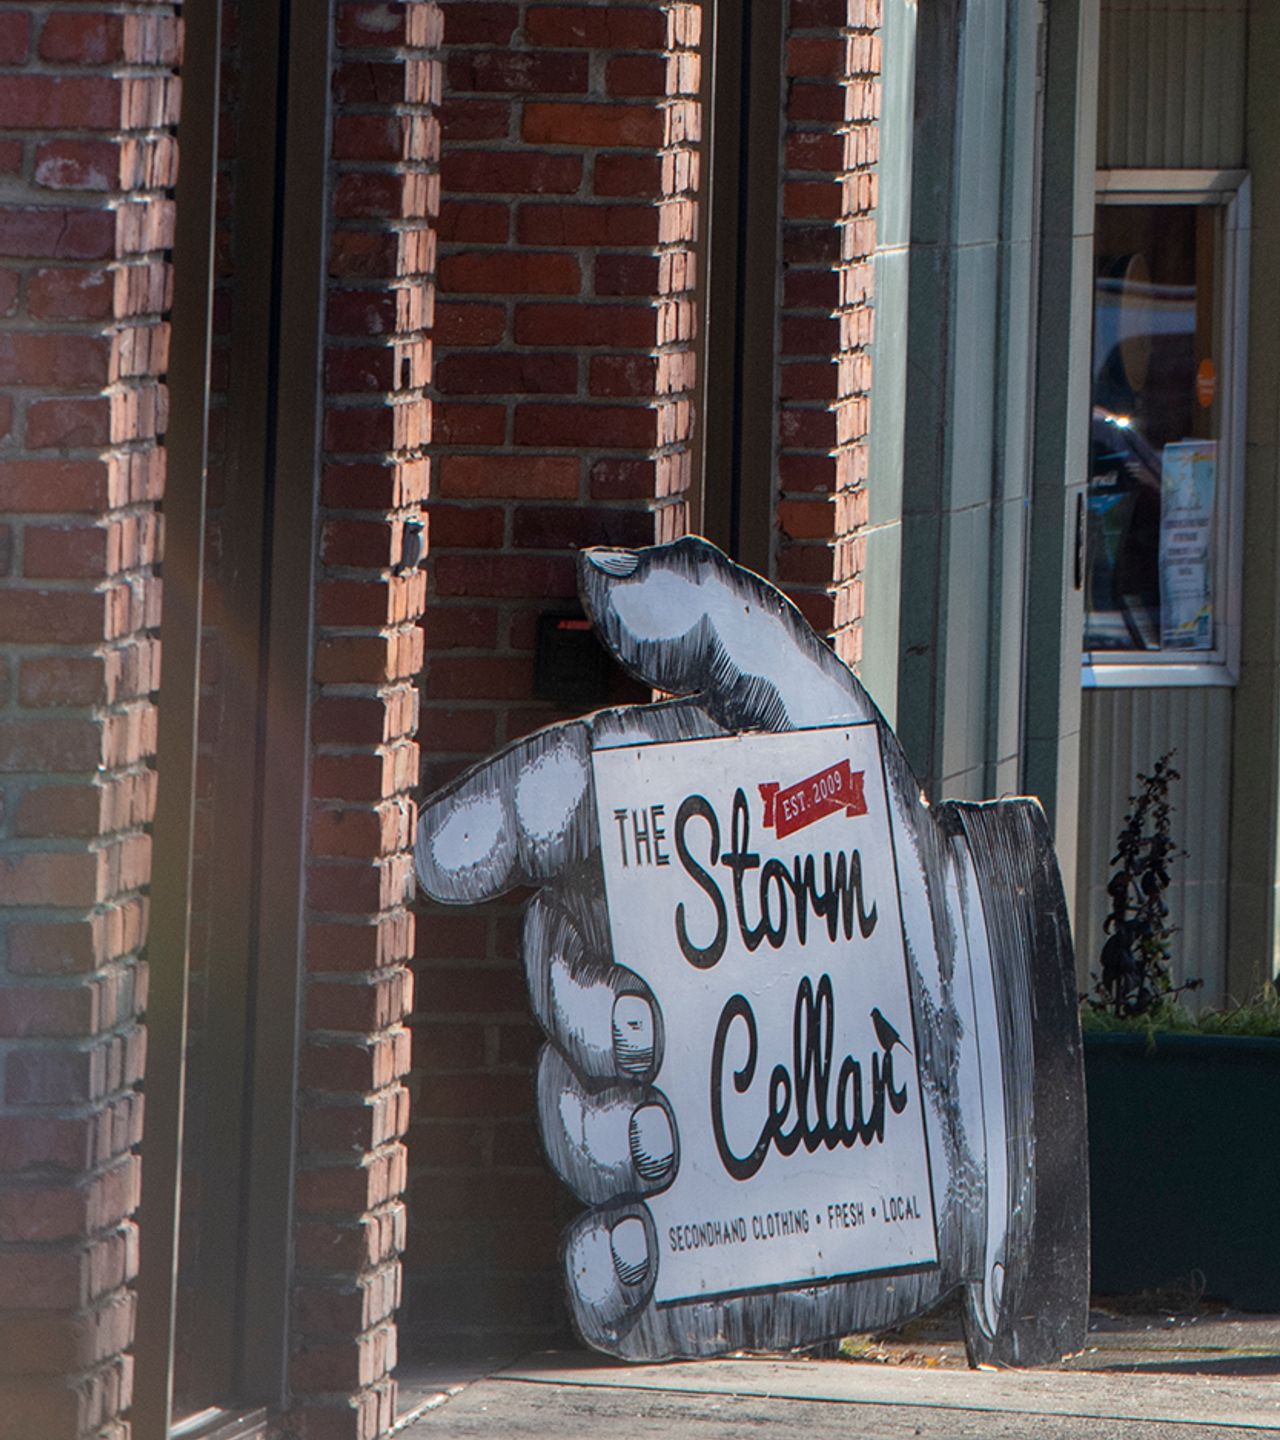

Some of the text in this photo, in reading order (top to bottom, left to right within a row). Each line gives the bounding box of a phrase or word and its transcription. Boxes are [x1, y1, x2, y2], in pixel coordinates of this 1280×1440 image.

[781, 769, 843, 823] EST. 2009
[613, 804, 672, 869] THE
[674, 786, 879, 971] Storm
[710, 972, 908, 1182] Cellar
[668, 1194, 922, 1252] SECONDHAND CLOTHING FRESH LOCAL
